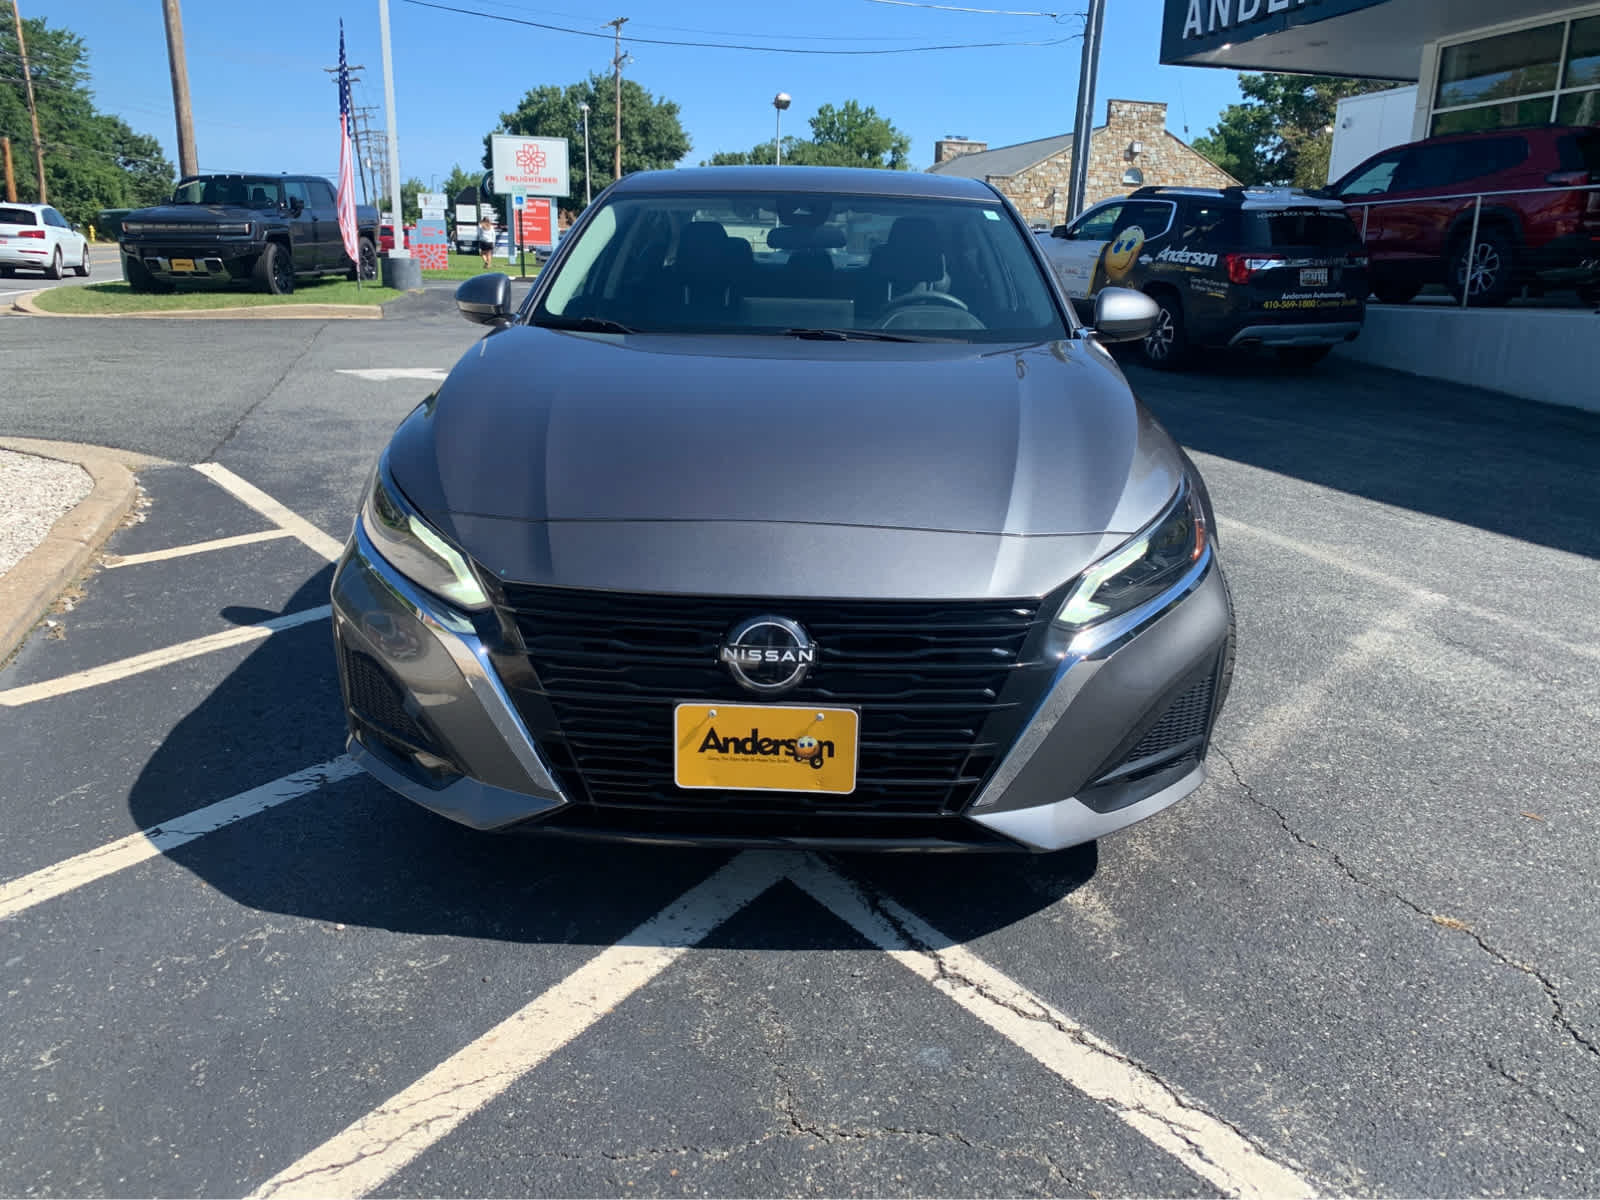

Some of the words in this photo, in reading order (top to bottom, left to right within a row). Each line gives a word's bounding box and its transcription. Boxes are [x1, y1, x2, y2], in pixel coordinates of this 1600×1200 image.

[1155, 244, 1218, 267] Anderson
[1282, 291, 1313, 300] Anderson
[723, 647, 813, 662] NISSAN
